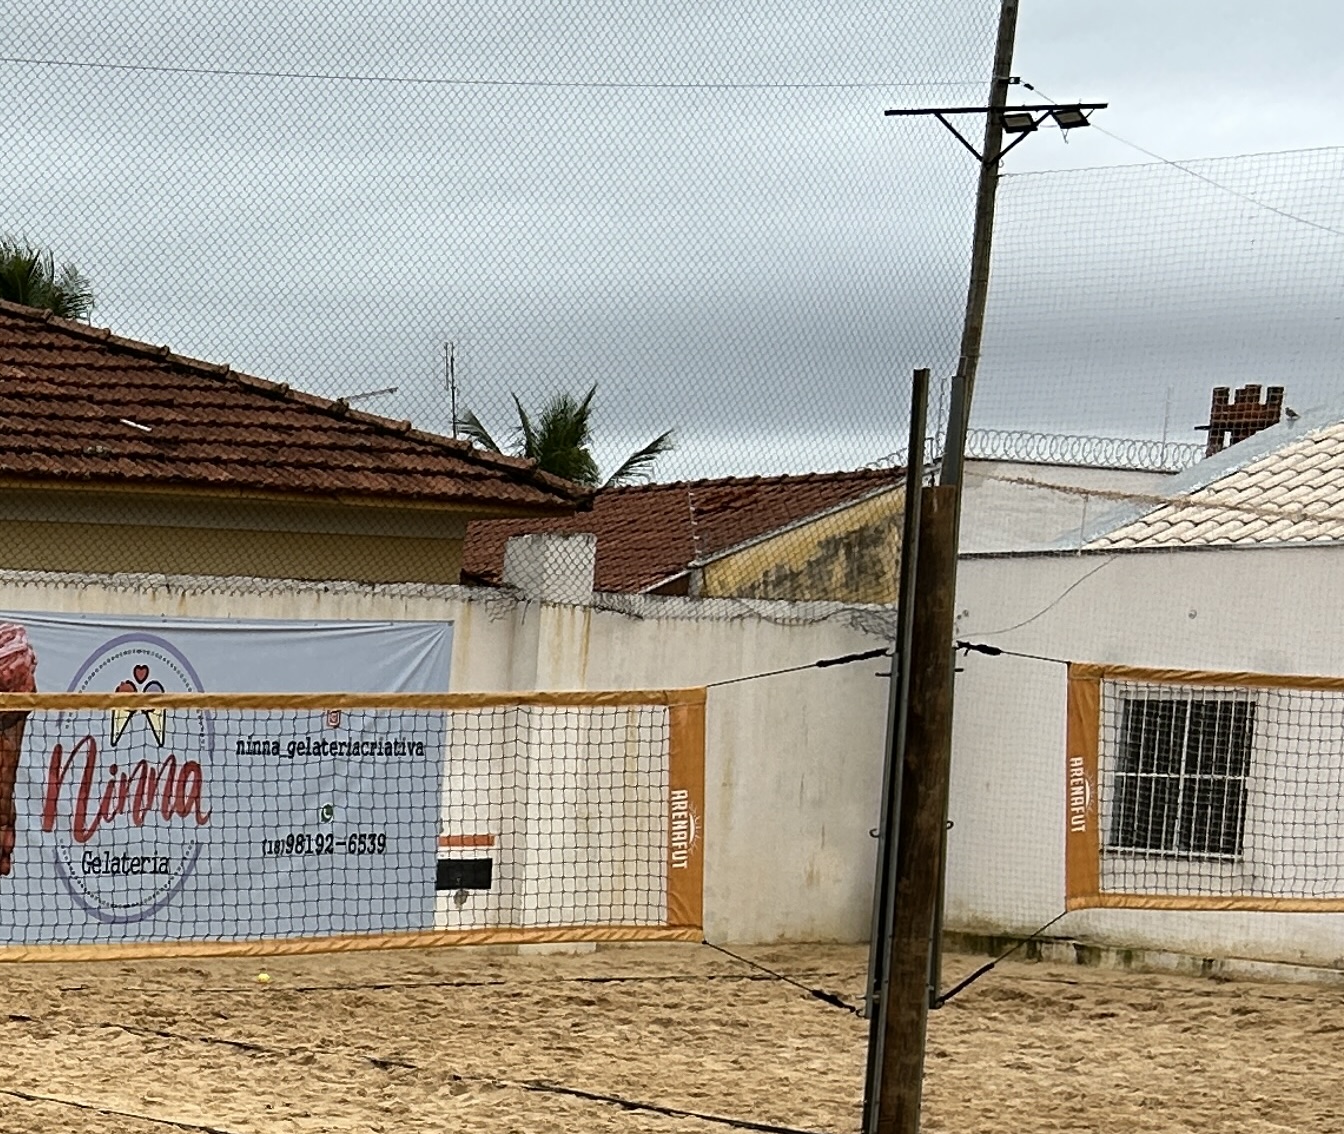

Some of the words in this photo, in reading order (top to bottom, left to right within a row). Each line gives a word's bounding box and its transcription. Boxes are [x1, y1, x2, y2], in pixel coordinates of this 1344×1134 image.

[42, 735, 212, 843] Ninna
[1070, 757, 1086, 832] ARENAFUT
[81, 850, 170, 876] Gelateria
[671, 789, 689, 870] ARENAFUT
